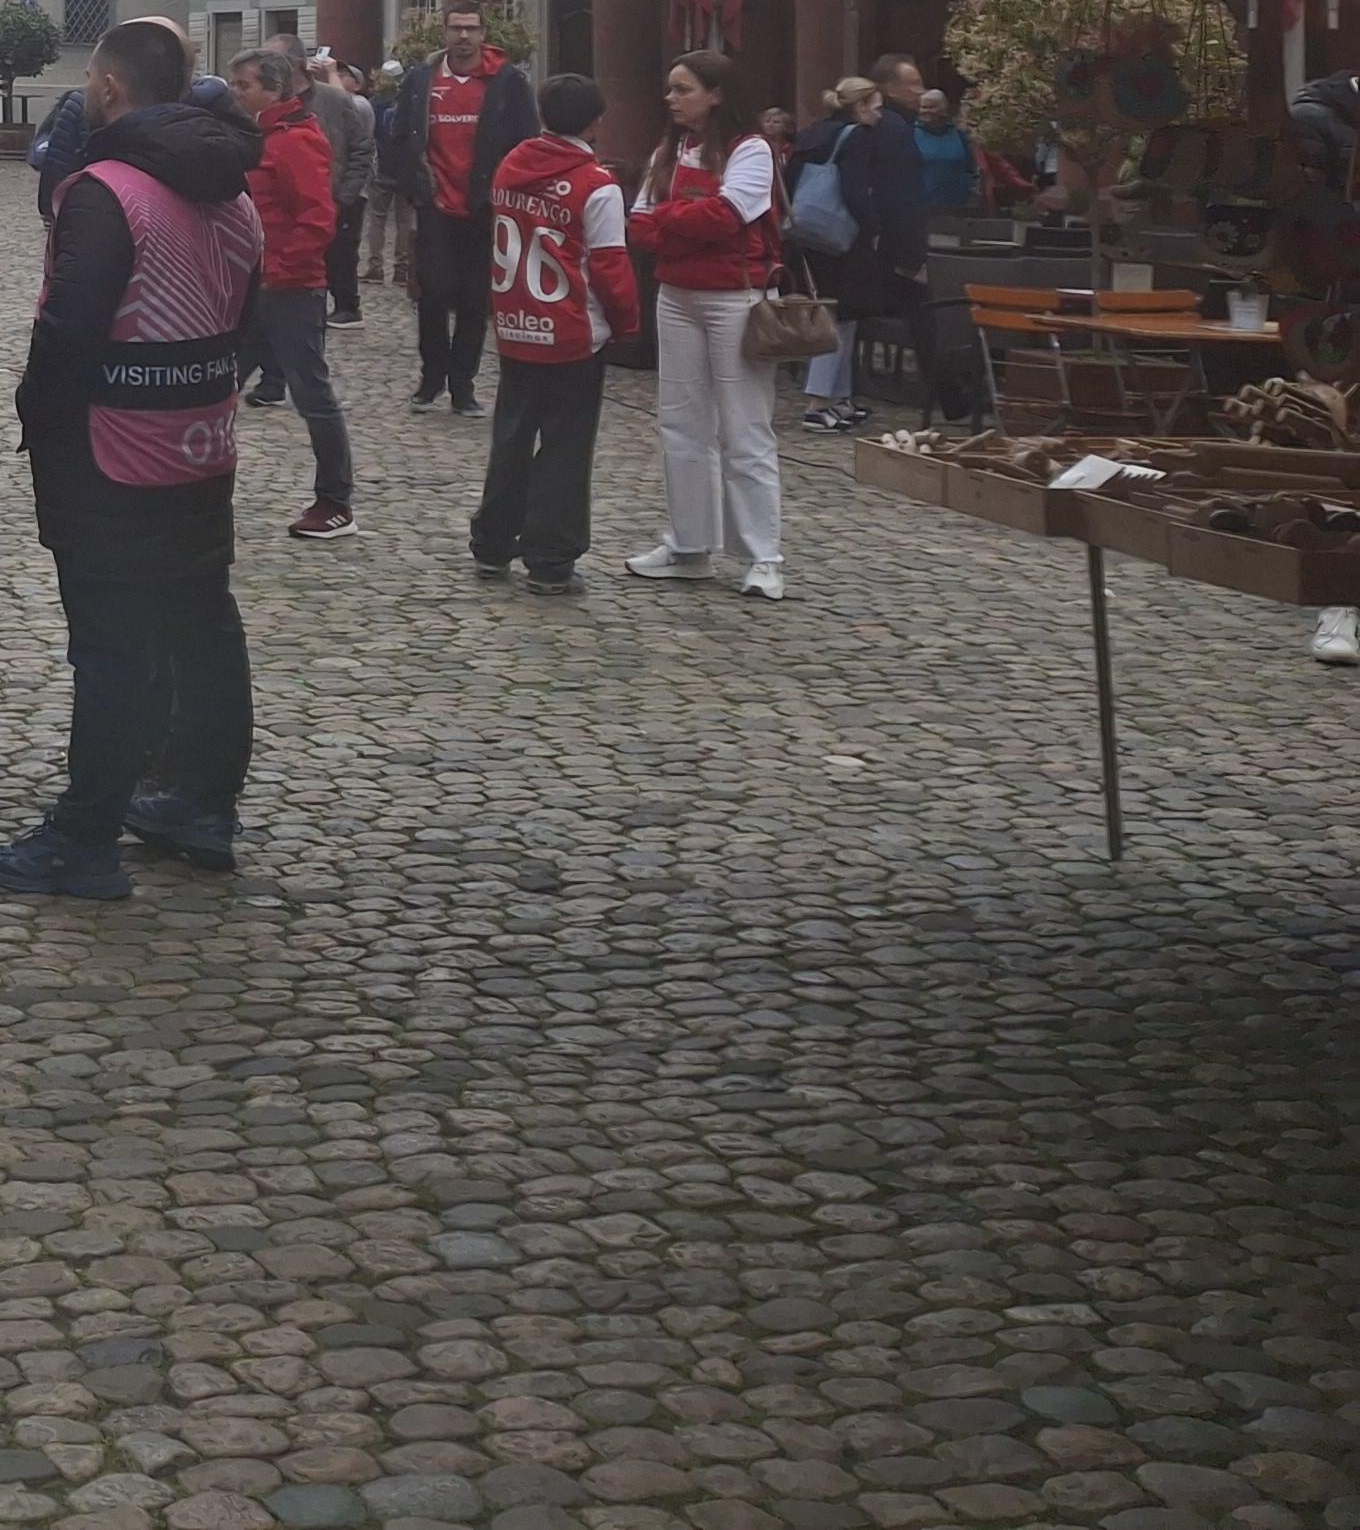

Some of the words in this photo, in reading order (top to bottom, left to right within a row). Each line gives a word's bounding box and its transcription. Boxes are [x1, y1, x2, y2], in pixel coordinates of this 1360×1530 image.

[491, 214, 570, 303] 96
[496, 309, 555, 332] soleo
[102, 363, 202, 387] VISITING
